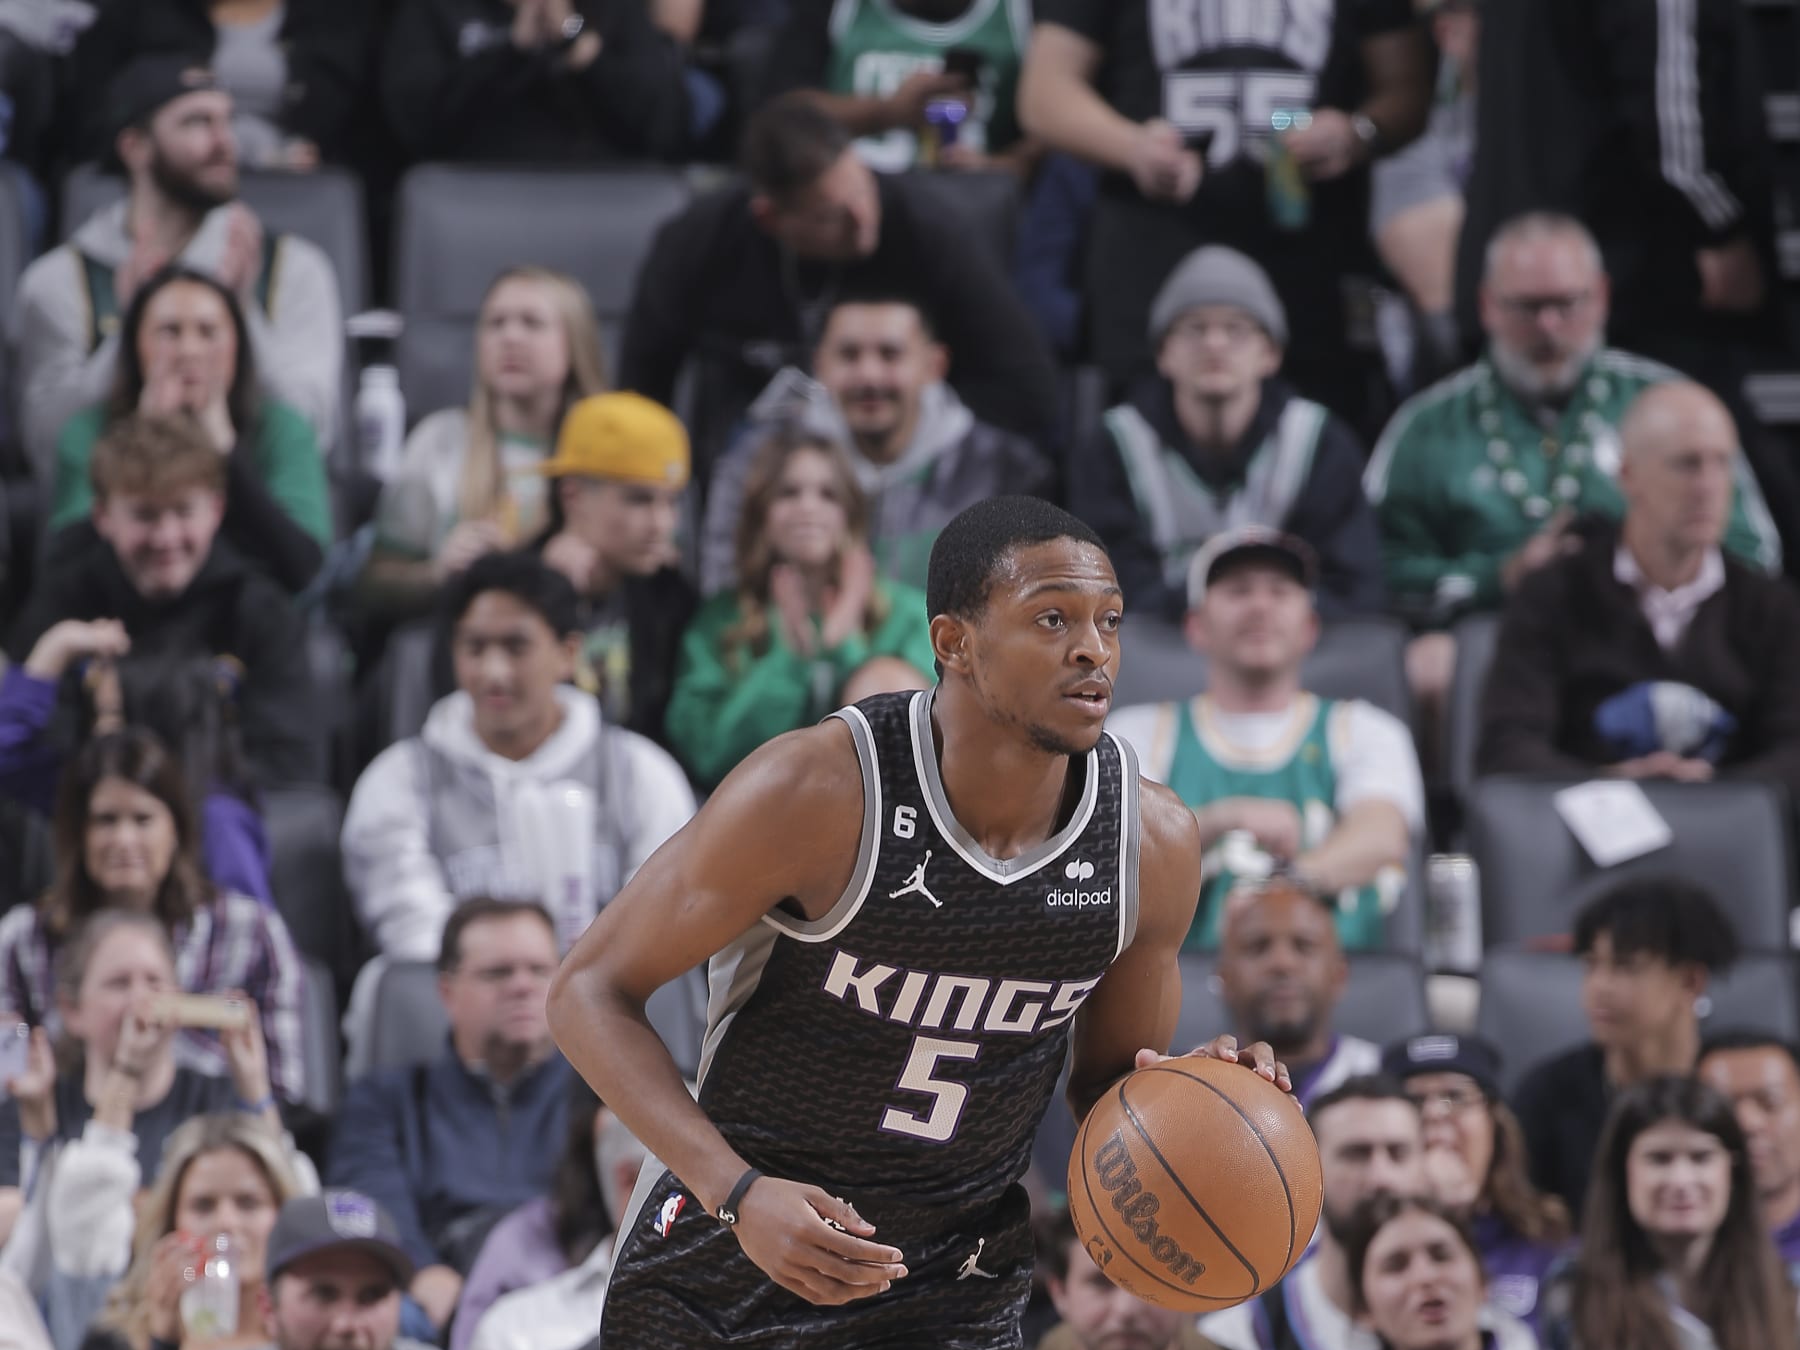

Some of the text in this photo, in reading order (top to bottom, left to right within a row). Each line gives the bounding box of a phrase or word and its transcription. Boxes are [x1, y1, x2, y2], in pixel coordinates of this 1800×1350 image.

[892, 804, 918, 839] 6
[1046, 885, 1112, 911] dialpad
[823, 949, 1105, 1034] KINGS
[877, 1033, 983, 1143] 5
[1093, 1127, 1206, 1286] Wilson
